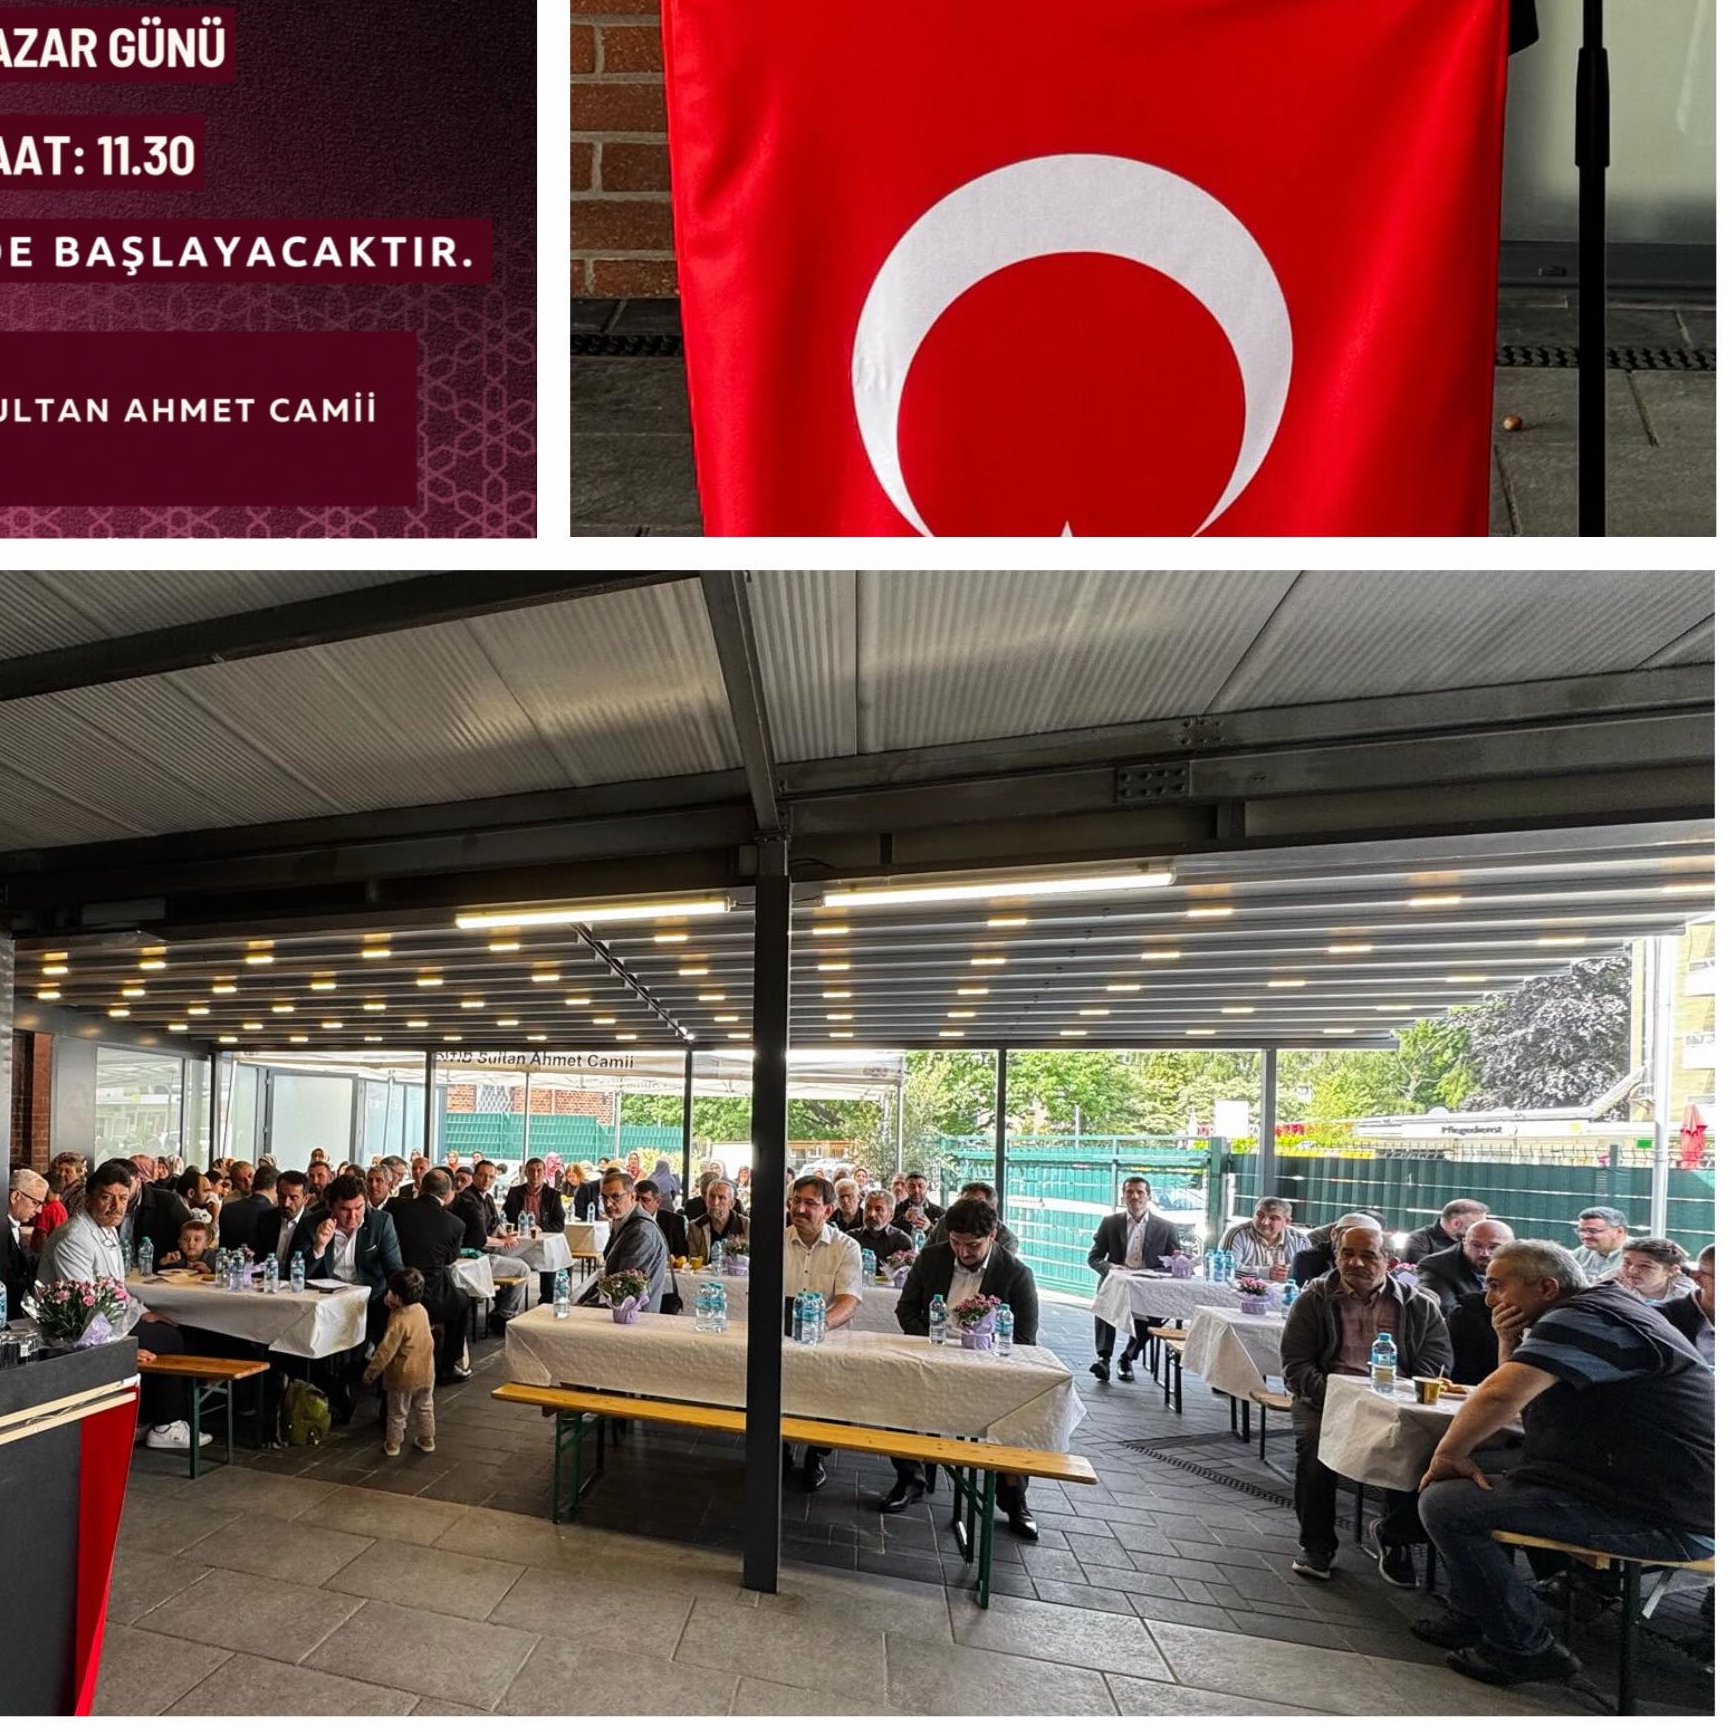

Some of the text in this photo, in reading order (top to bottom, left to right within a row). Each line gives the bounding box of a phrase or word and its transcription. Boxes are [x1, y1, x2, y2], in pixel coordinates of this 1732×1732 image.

[109, 16, 225, 68] GÜNÜ
[97, 135, 195, 176] 11.30
[55, 236, 473, 276] BAŞLAYACAKTIR.
[124, 398, 255, 422] AHMET
[269, 391, 376, 423] CAMİİ
[477, 1051, 526, 1065] Sultan
[530, 1050, 582, 1067] Ahmet
[587, 1054, 634, 1069] Camii
